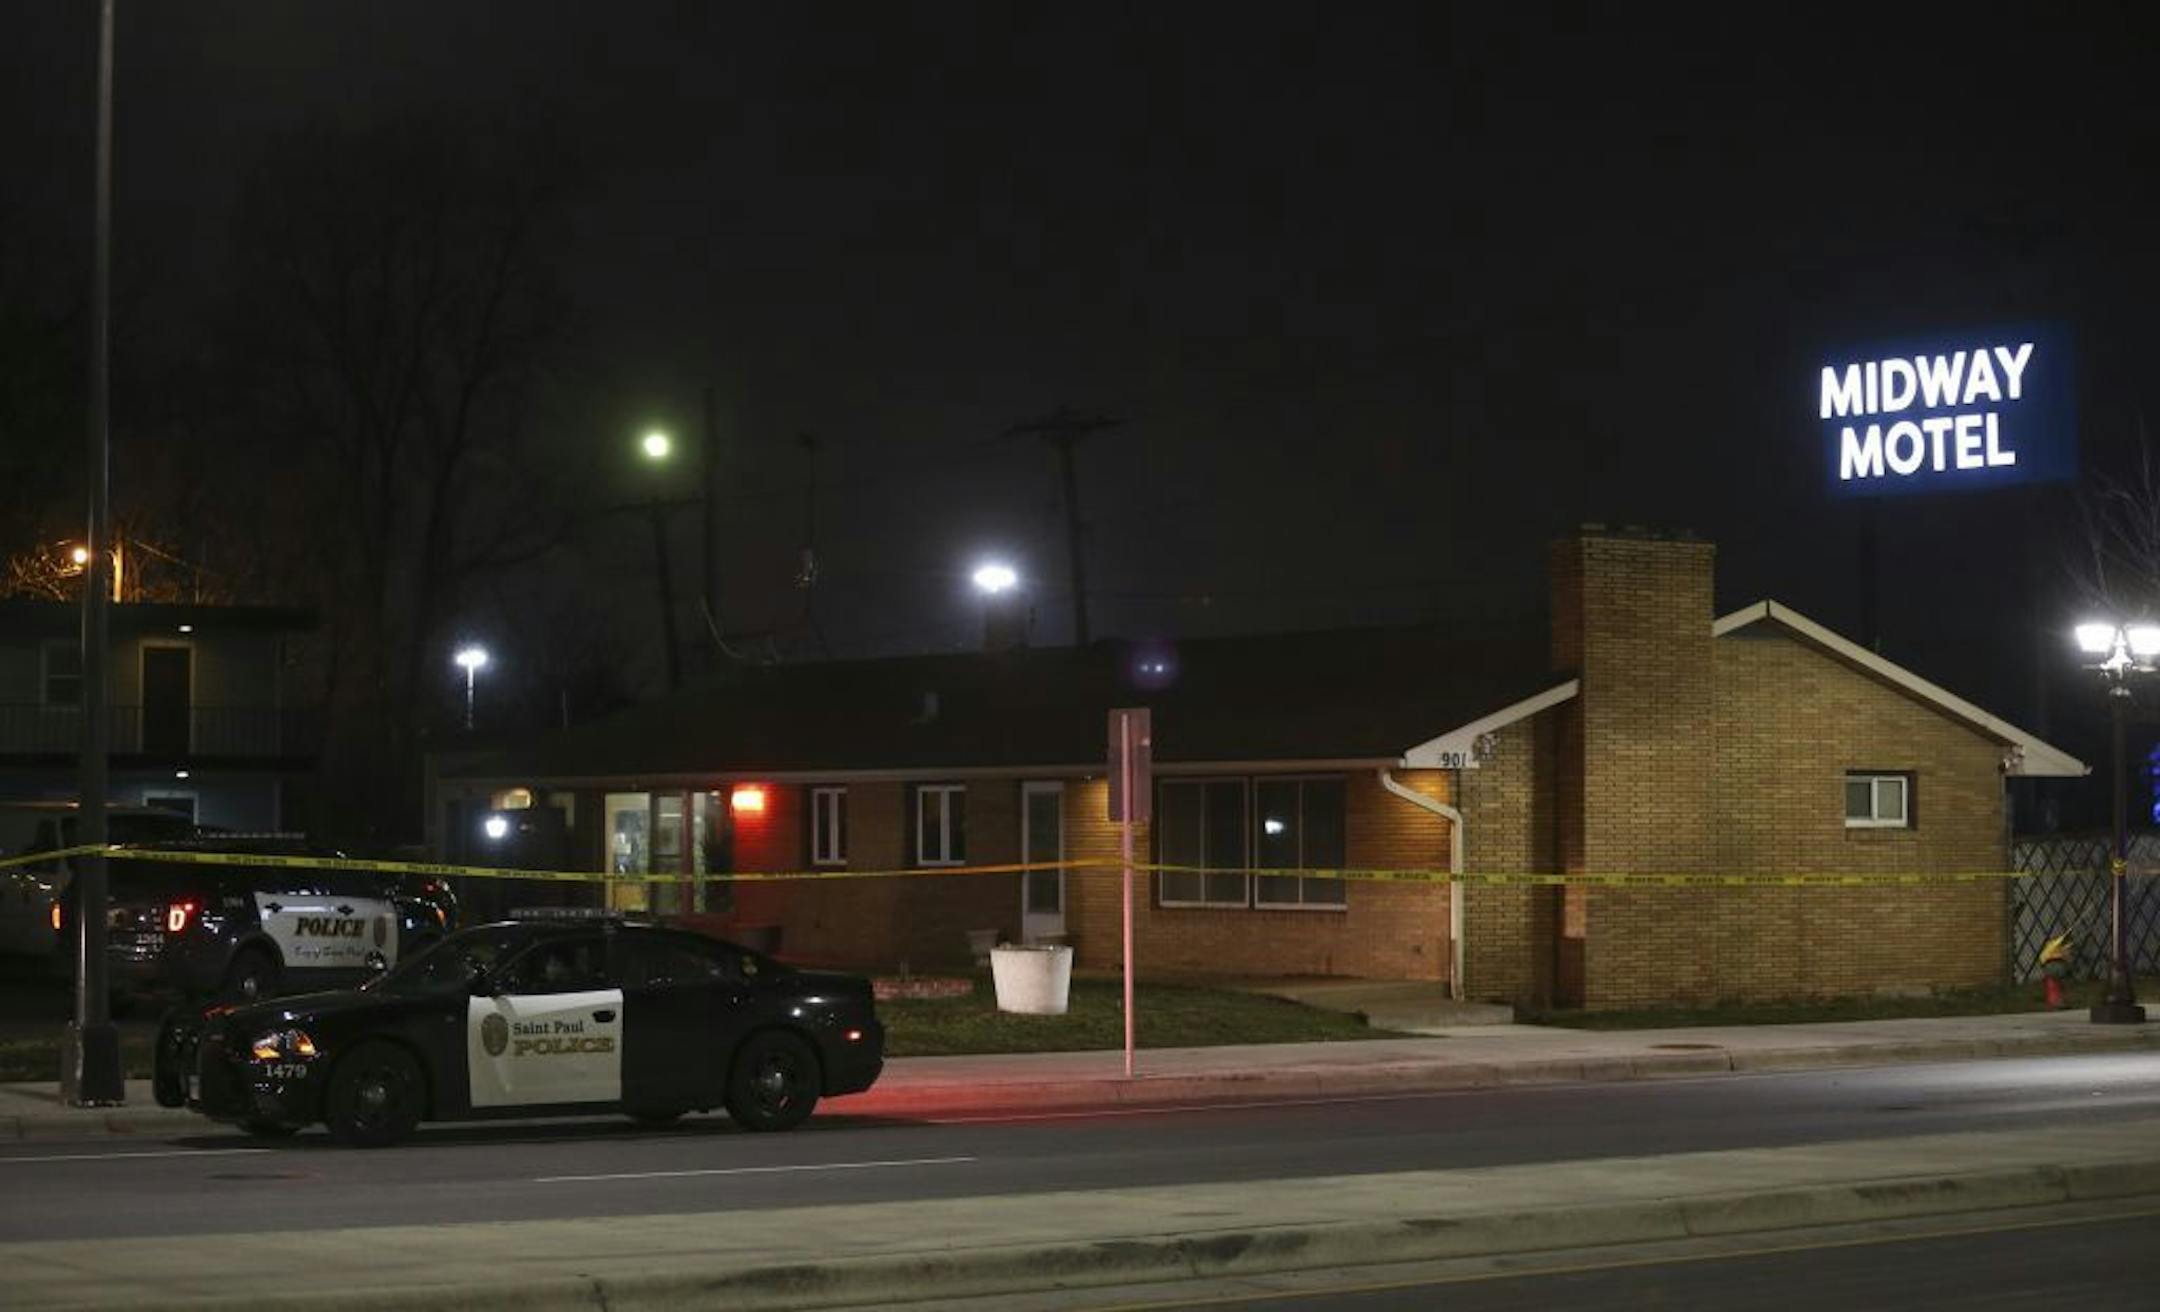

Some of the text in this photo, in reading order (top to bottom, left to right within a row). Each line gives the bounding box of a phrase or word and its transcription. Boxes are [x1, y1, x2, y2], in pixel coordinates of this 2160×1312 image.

[1819, 343, 2034, 419] MIDWAY
[1840, 412, 2016, 480] MOTEL
[1442, 752, 1466, 767] 901
[295, 917, 365, 937] POLICE
[513, 1020, 584, 1035] Saint Paul
[513, 1037, 614, 1056] POLICE
[265, 1064, 307, 1078] 1479
